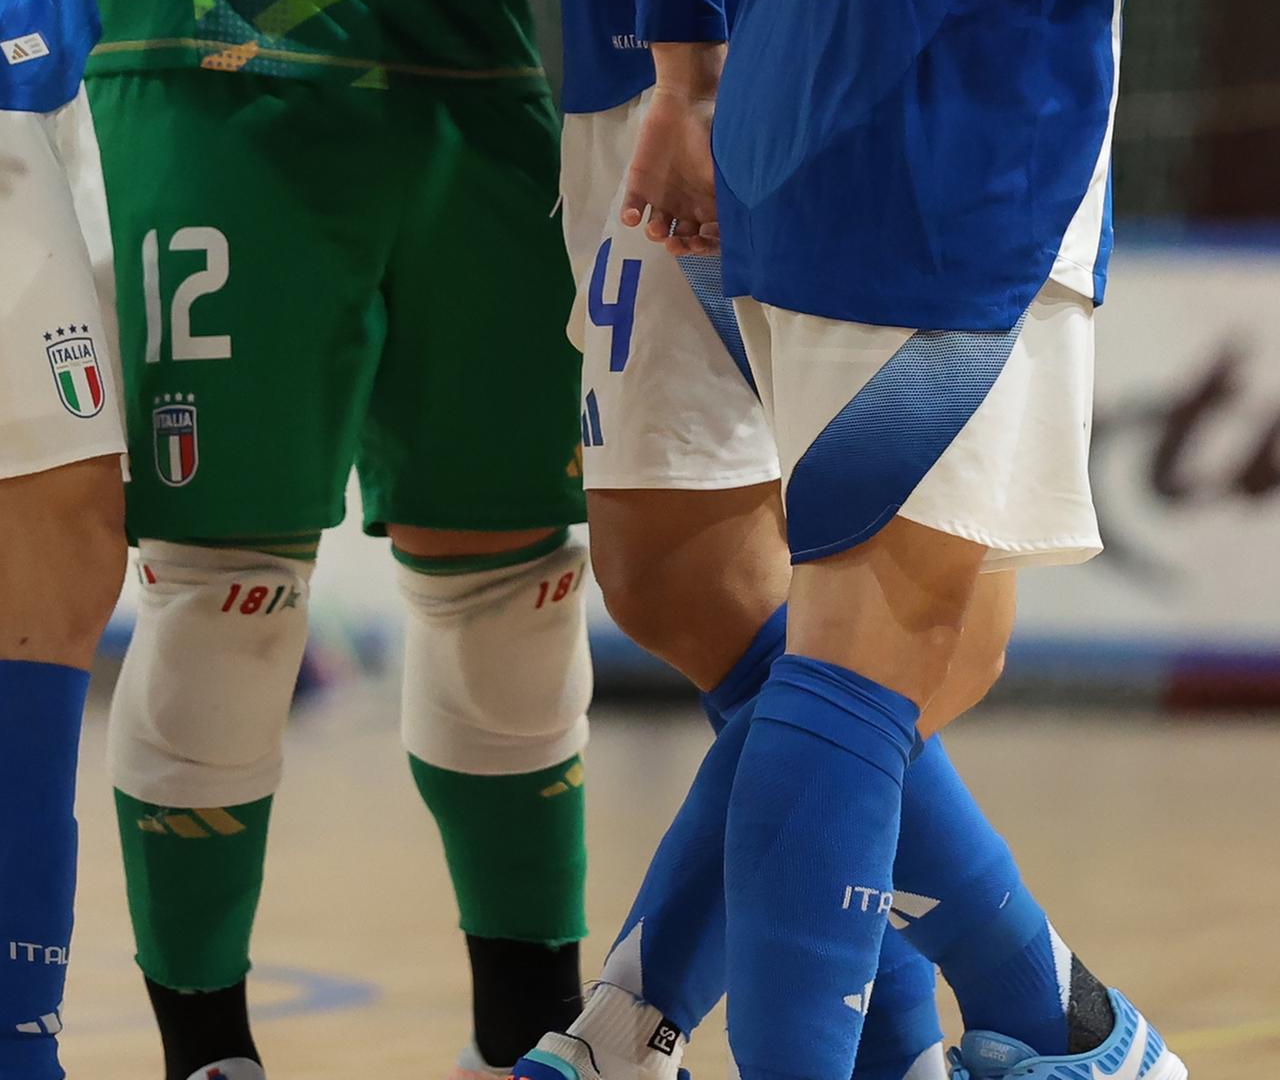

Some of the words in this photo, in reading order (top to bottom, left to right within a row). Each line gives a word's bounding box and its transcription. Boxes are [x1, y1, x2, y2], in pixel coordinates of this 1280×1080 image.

[141, 226, 232, 363] 12
[587, 237, 642, 373] 4
[51, 343, 92, 365] ITALIA
[155, 411, 193, 428] ITALIA
[653, 1025, 677, 1052] FS
